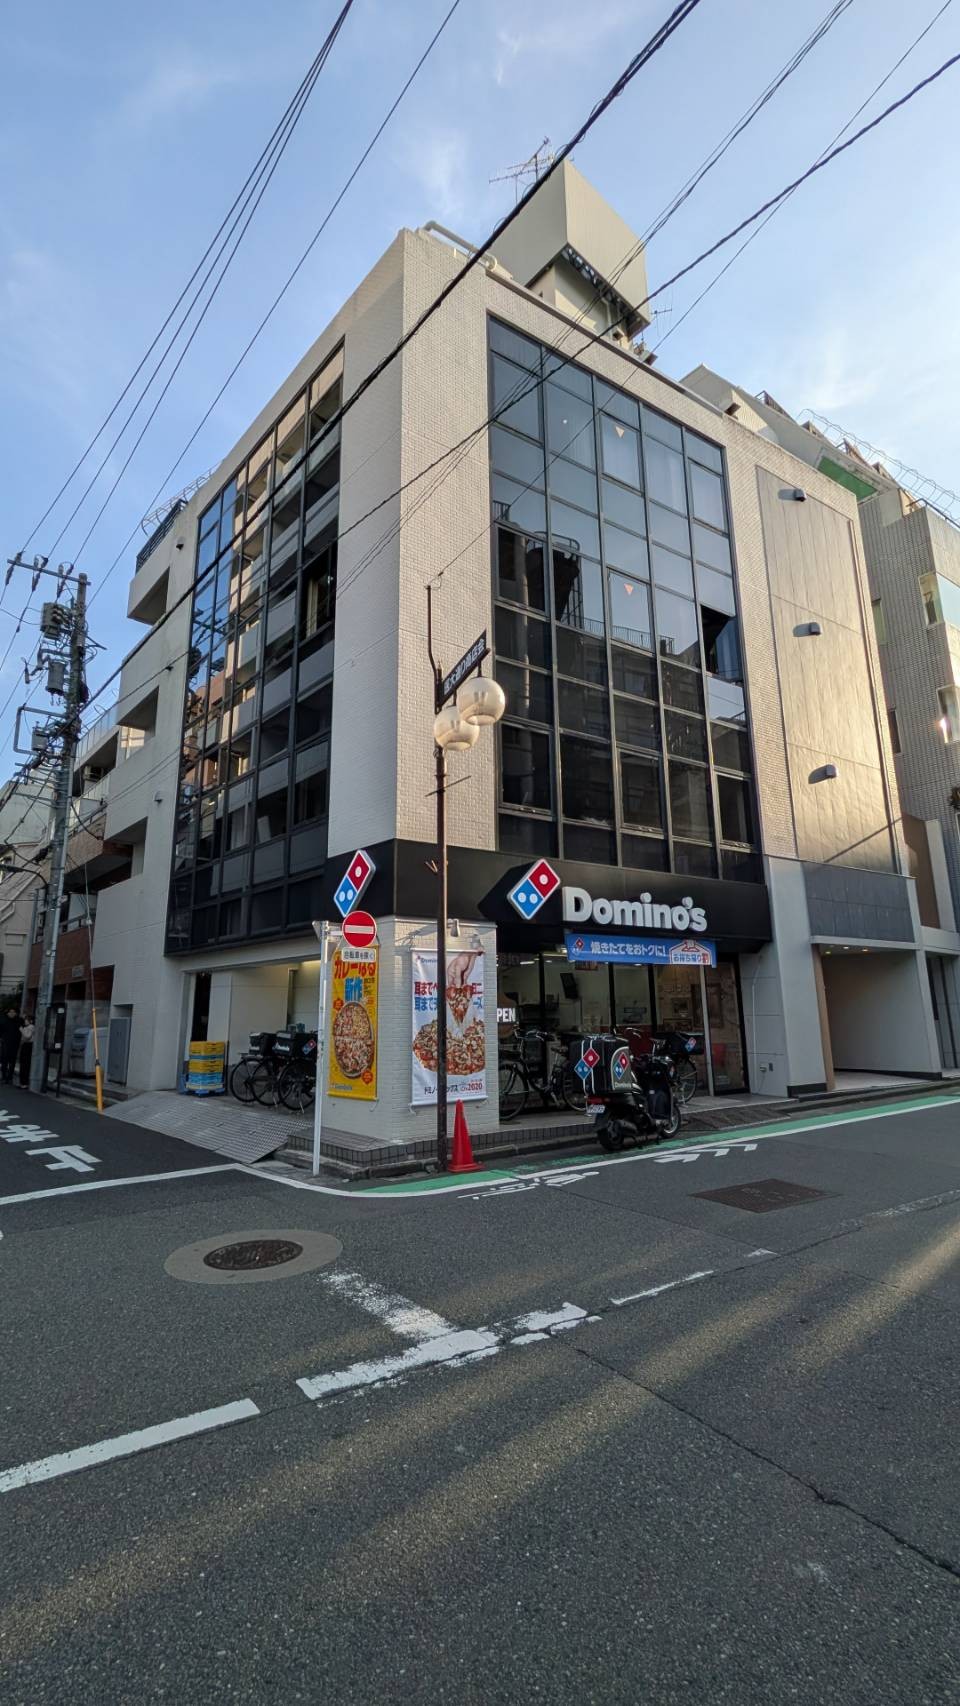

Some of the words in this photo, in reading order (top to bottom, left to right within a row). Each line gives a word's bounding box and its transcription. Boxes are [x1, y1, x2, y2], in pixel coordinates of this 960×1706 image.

[562, 886, 708, 932] Domino's
[345, 976, 363, 1002] 新作
[496, 1007, 516, 1022] PEN
